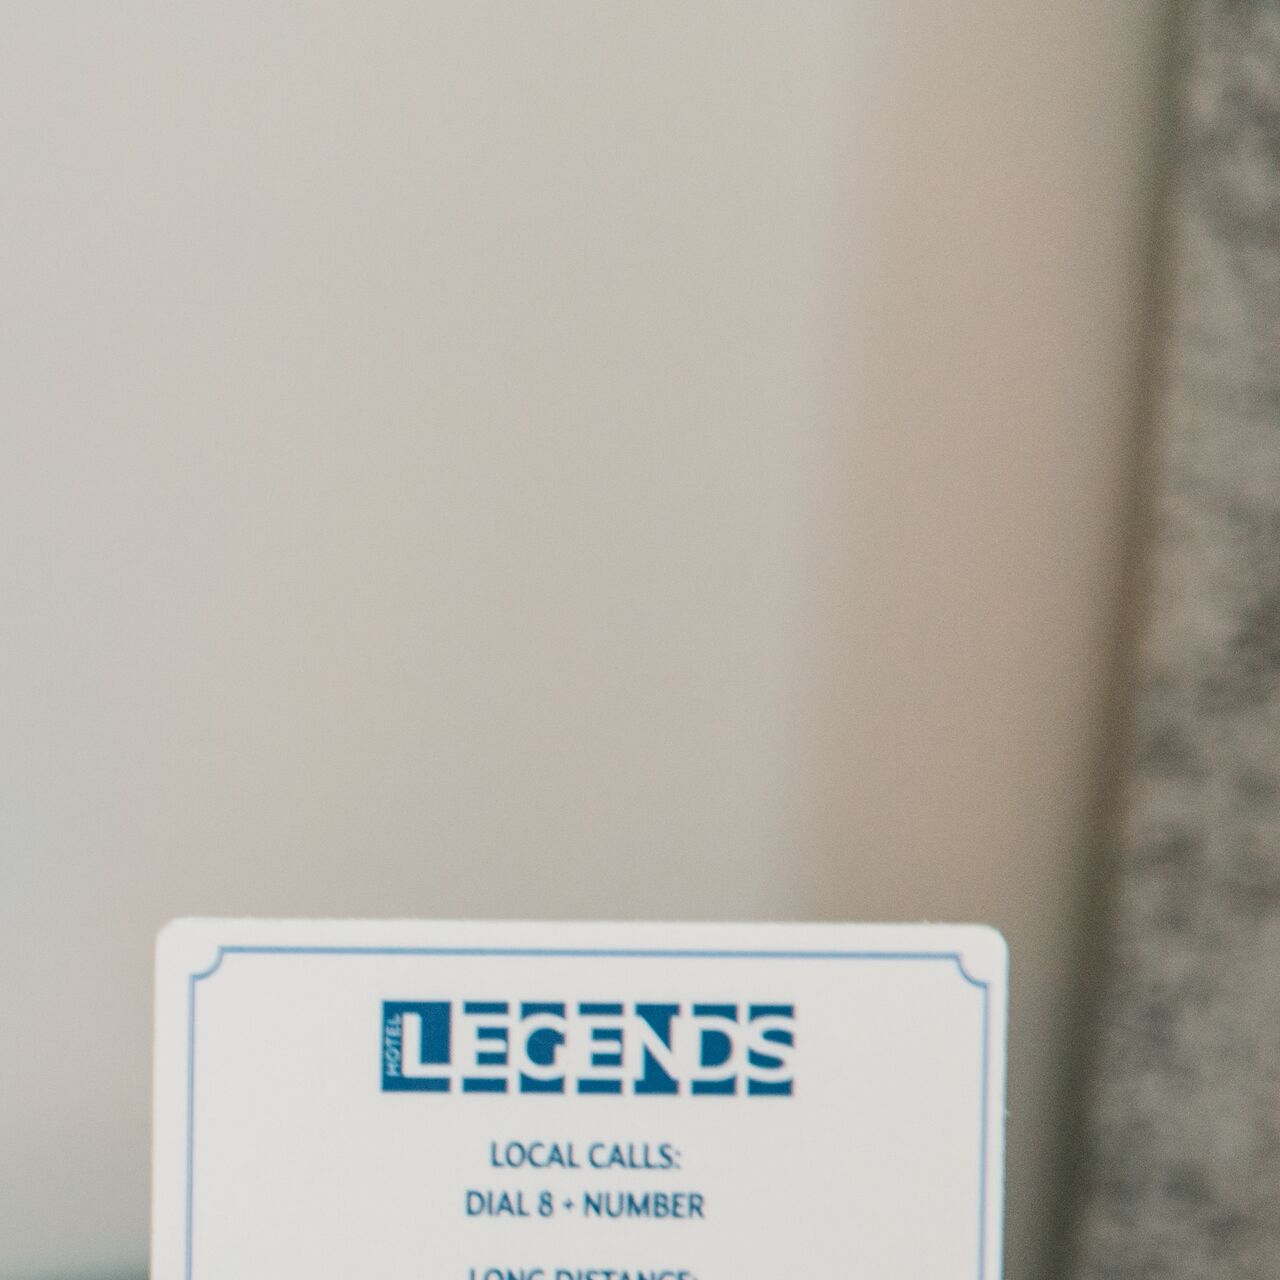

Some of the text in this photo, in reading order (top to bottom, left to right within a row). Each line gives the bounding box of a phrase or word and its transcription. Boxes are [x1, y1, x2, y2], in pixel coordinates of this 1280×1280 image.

[384, 1012, 403, 1078] HOTEL
[402, 1001, 796, 1095] LEGENDS
[490, 1141, 680, 1170] LOCAL CALLS:
[465, 1189, 704, 1219] DIAL 8 + NUMBER
